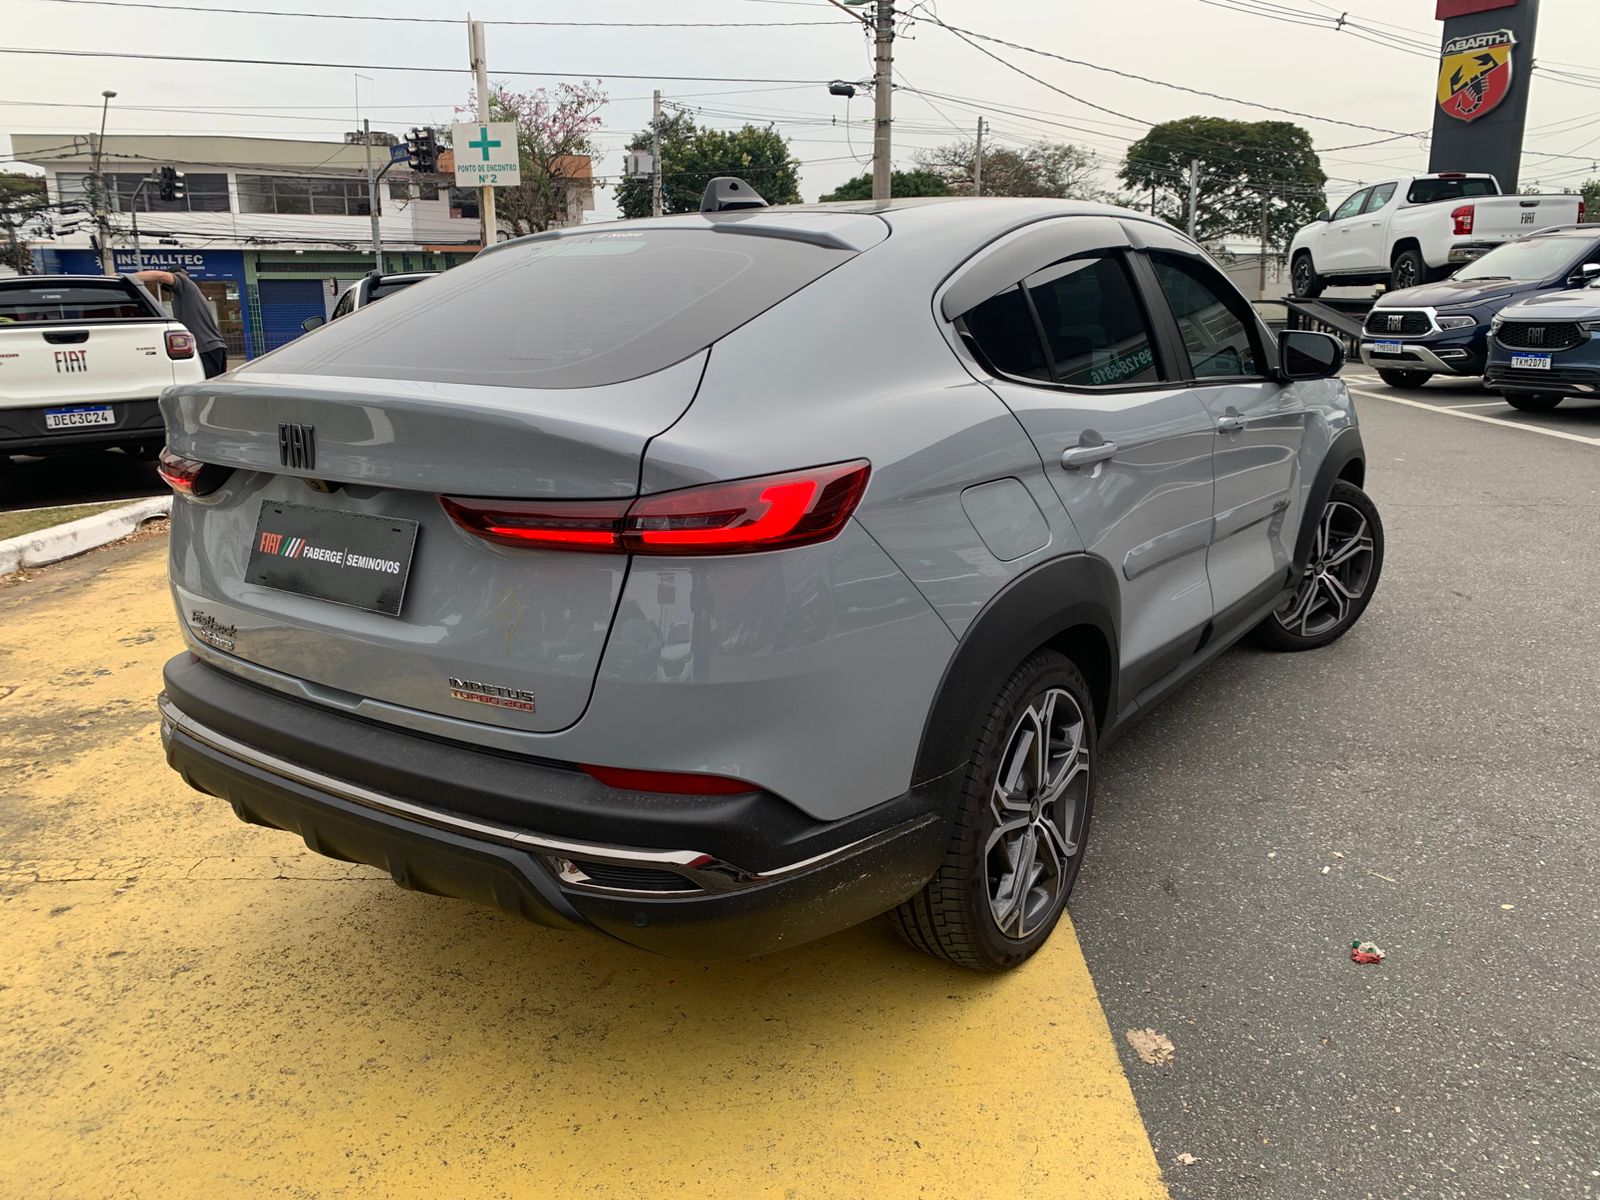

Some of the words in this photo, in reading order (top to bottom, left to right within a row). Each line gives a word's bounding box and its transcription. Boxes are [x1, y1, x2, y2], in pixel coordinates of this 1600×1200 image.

[1445, 34, 1508, 53] ABARTH
[457, 164, 476, 172] PONTO
[477, 164, 486, 172] DE
[486, 163, 517, 172] ENCONTRO
[490, 174, 498, 183] 2
[1520, 212, 1536, 224] FIAT
[117, 254, 204, 265] INSTALLTEC
[1387, 315, 1403, 330] FIAT
[1527, 327, 1545, 344] FIAT
[54, 350, 87, 373] FIAT
[53, 412, 108, 426] DEC3C24
[278, 423, 315, 470] FIAT
[259, 532, 283, 555] FIAT
[303, 546, 343, 564] FABERGE
[346, 554, 400, 574] SEMINOVOS
[449, 677, 535, 702] IMPETUS
[450, 688, 500, 705] TURBO
[502, 698, 534, 711] 200
